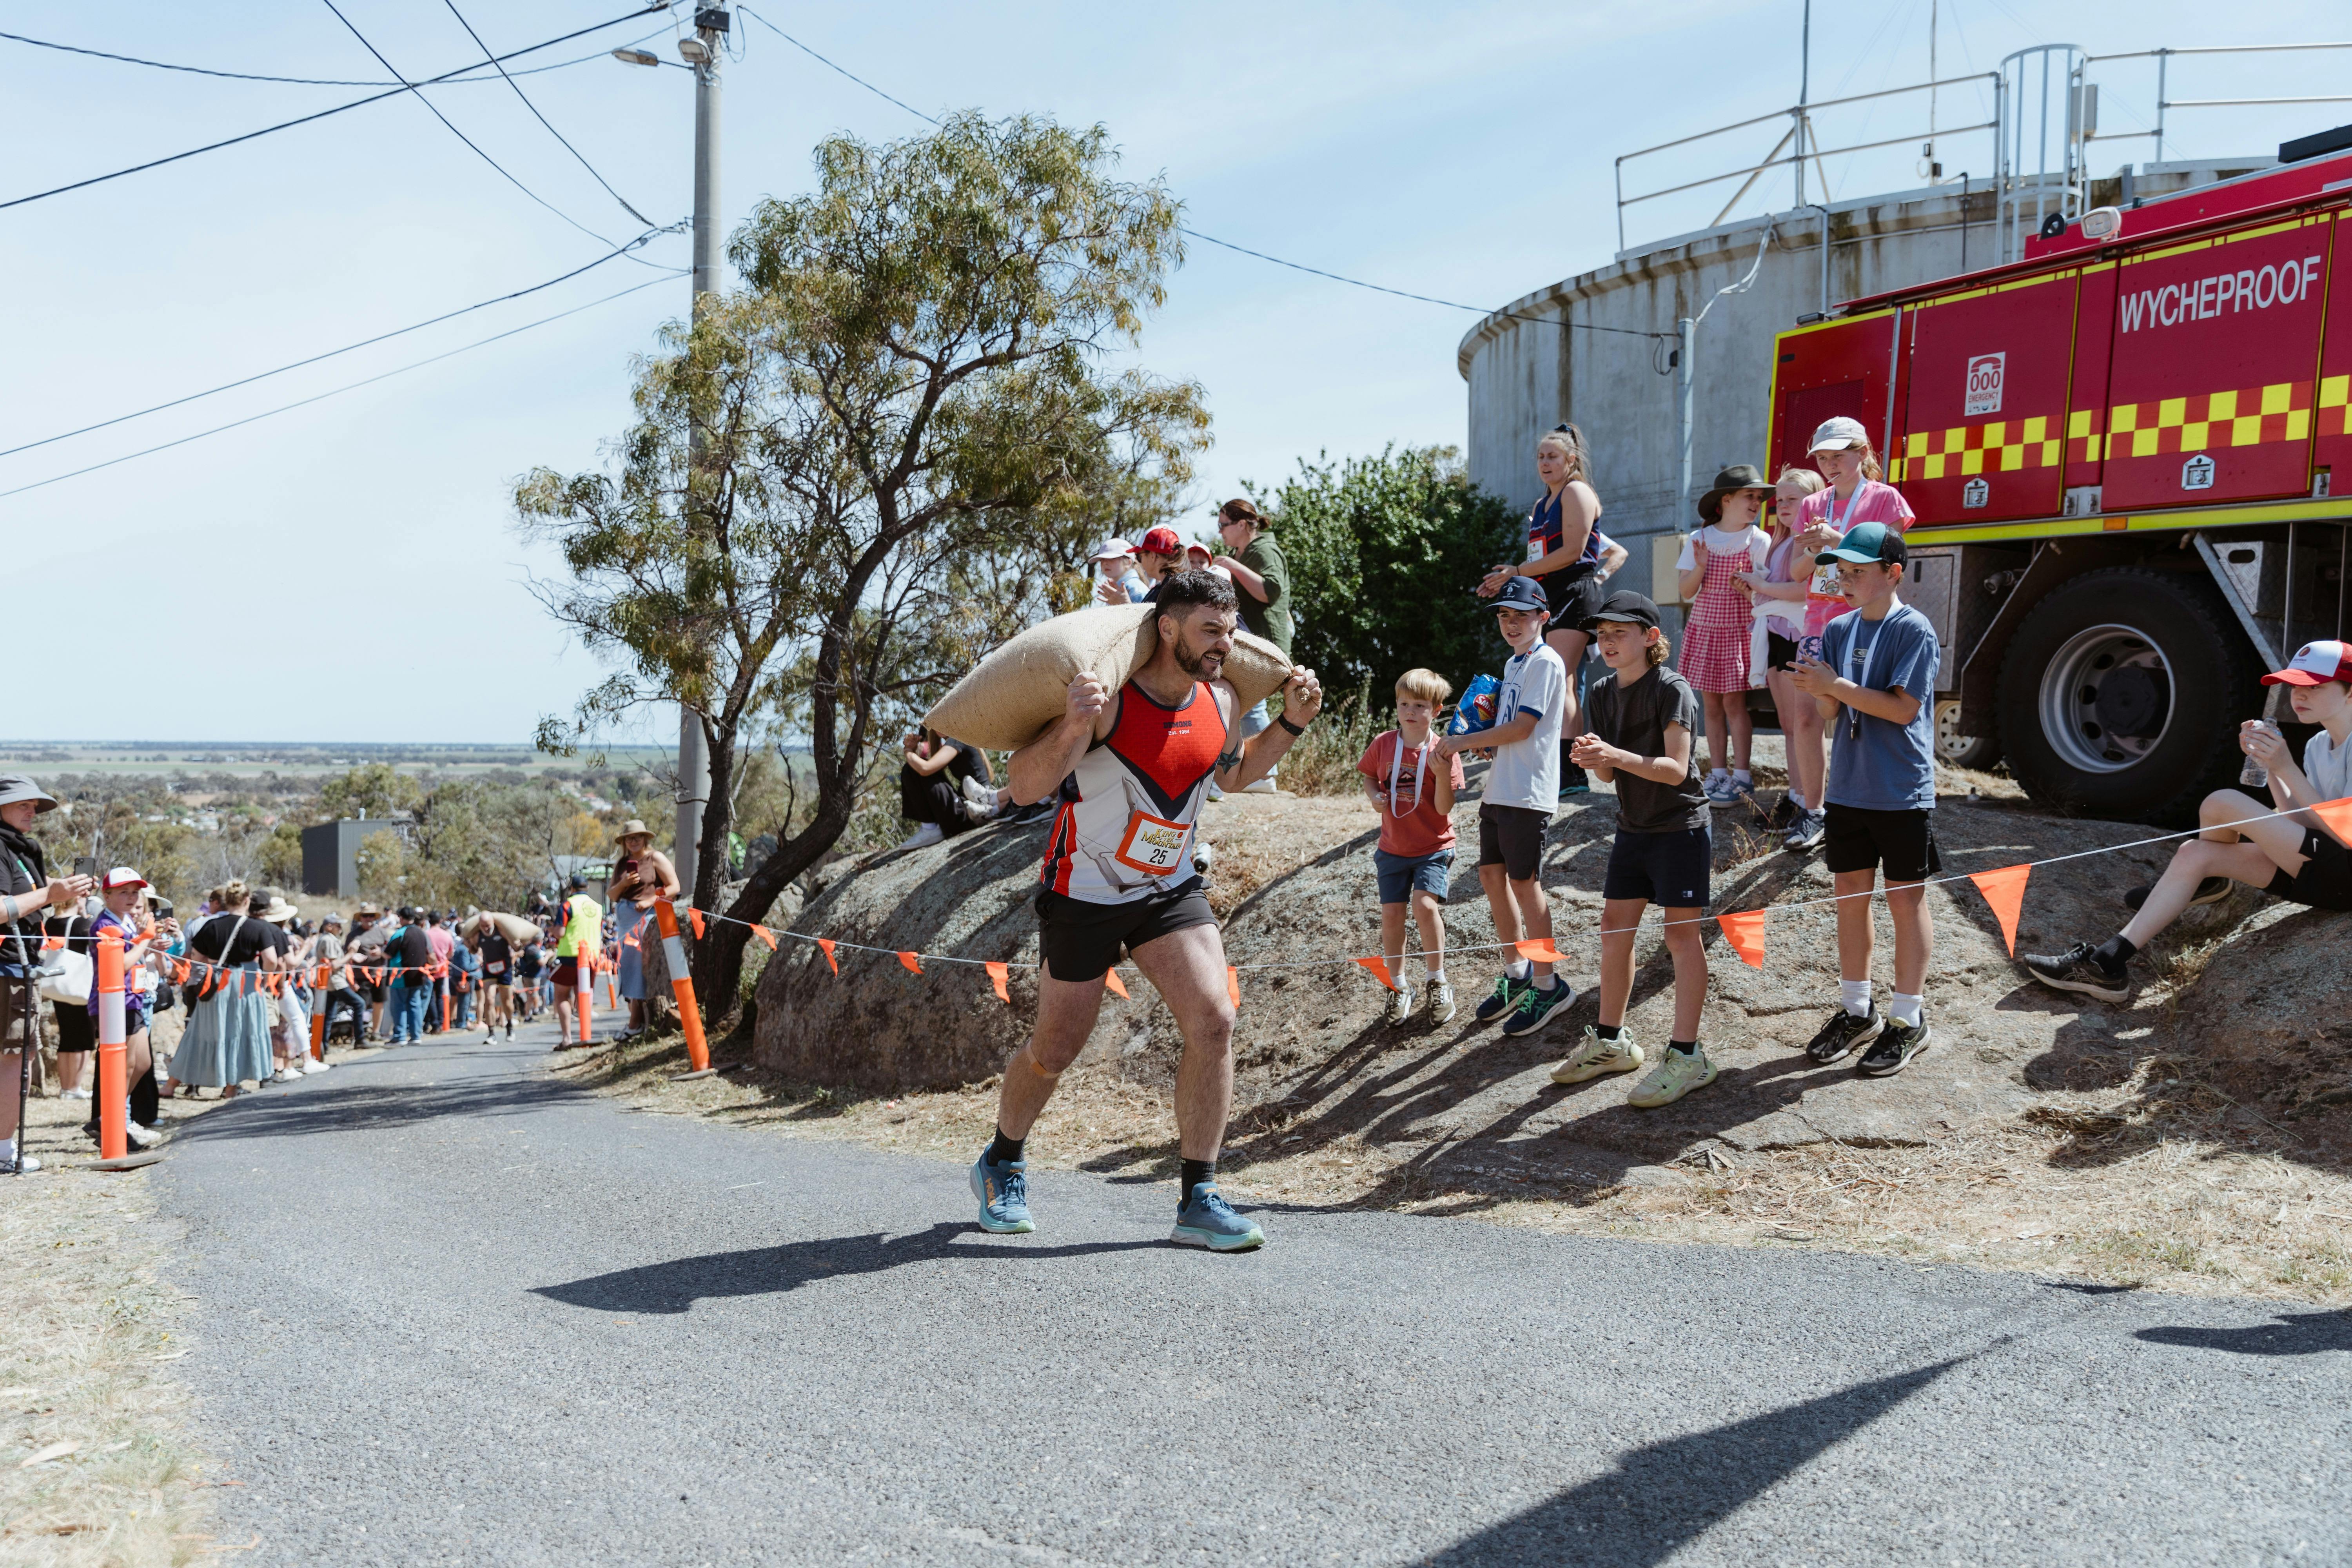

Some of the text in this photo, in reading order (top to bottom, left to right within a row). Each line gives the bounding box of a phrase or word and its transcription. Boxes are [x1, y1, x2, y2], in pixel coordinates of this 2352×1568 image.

[2121, 255, 2321, 333] WYCHEPROOF
[1970, 370, 2000, 392] 000
[1968, 391, 1999, 403] EMERGENCY
[1141, 831, 1182, 849] MOUNTAIN
[1154, 828, 1176, 838] KING
[1149, 848, 1168, 865] 25
[985, 1177, 997, 1209] HOKA
